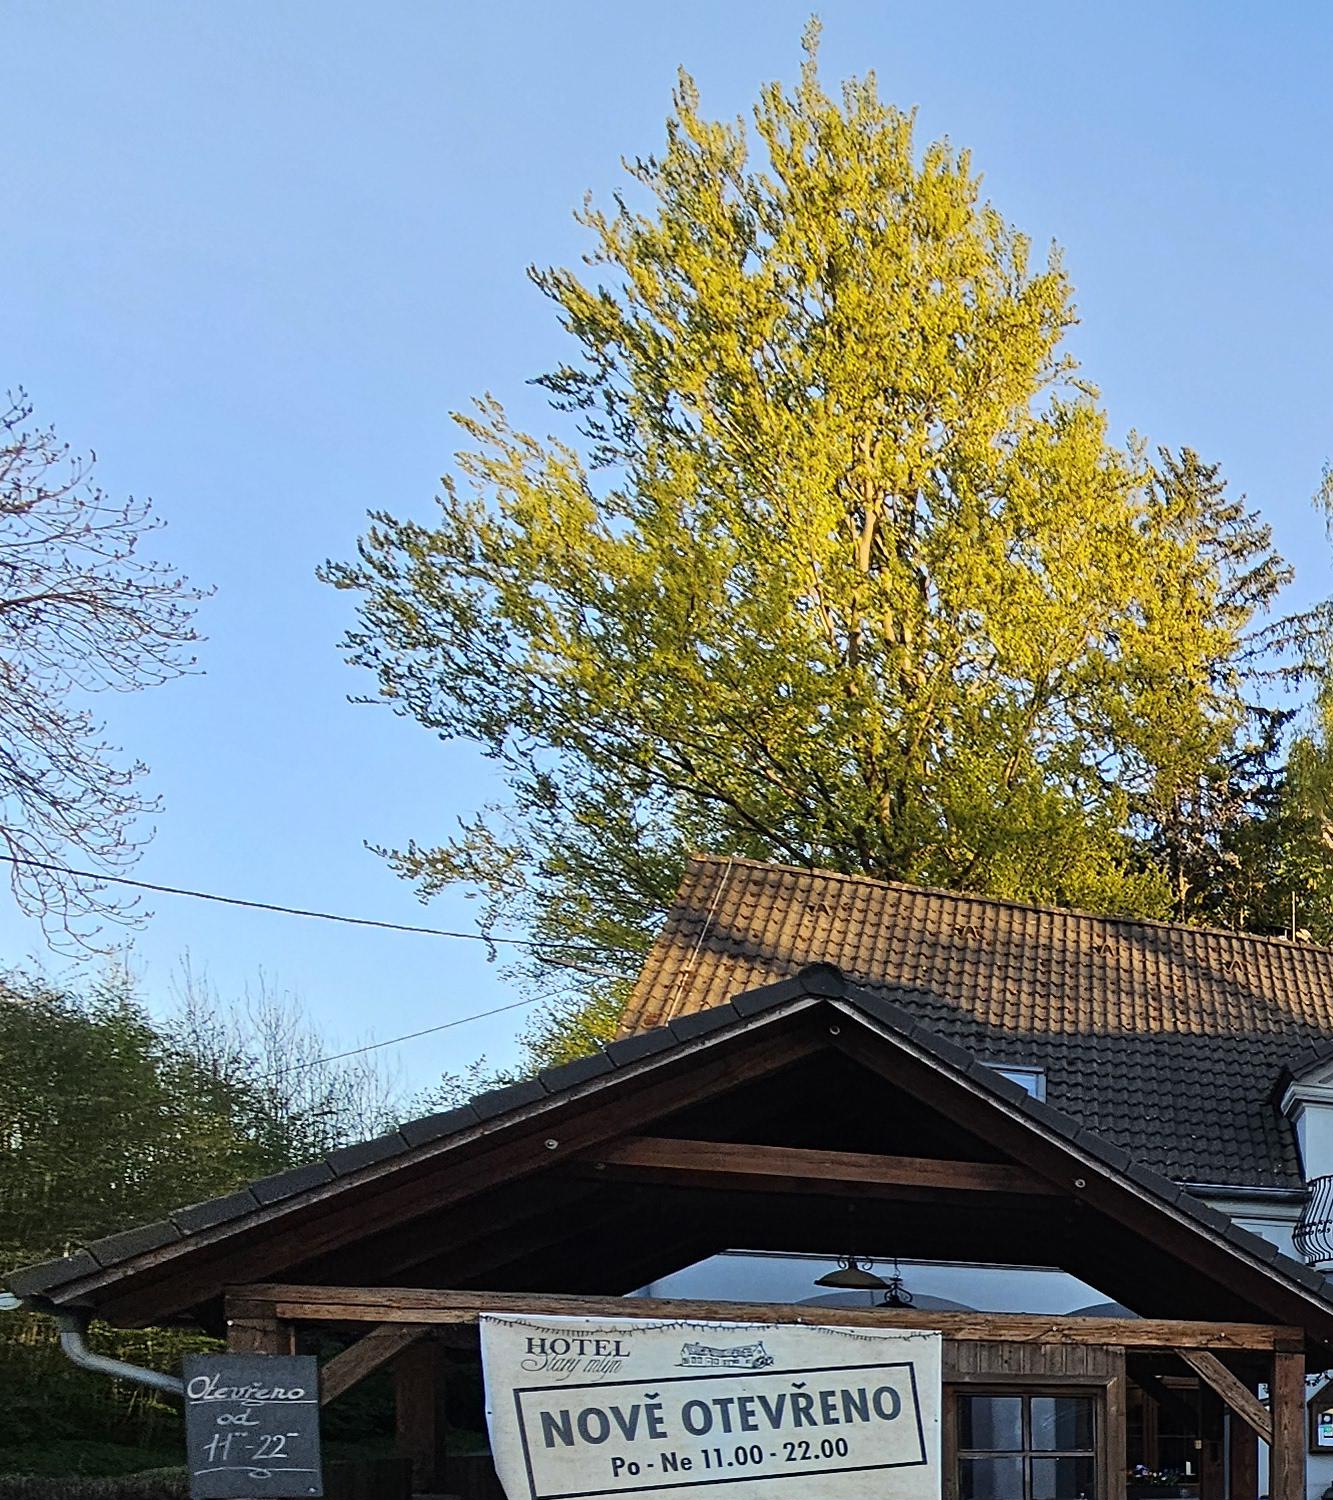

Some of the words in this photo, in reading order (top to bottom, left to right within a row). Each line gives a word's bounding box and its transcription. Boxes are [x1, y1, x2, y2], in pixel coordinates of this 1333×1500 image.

[525, 1336, 631, 1358] HOTEL
[186, 1372, 306, 1400] Otevřeno
[216, 1408, 261, 1426] od
[540, 1392, 668, 1448] NOVĚ
[681, 1381, 902, 1437] OTEVŘENO
[610, 1456, 641, 1478] Po
[660, 1452, 693, 1473] Ne
[700, 1445, 764, 1469] 11.00
[782, 1437, 850, 1463] 22.00
